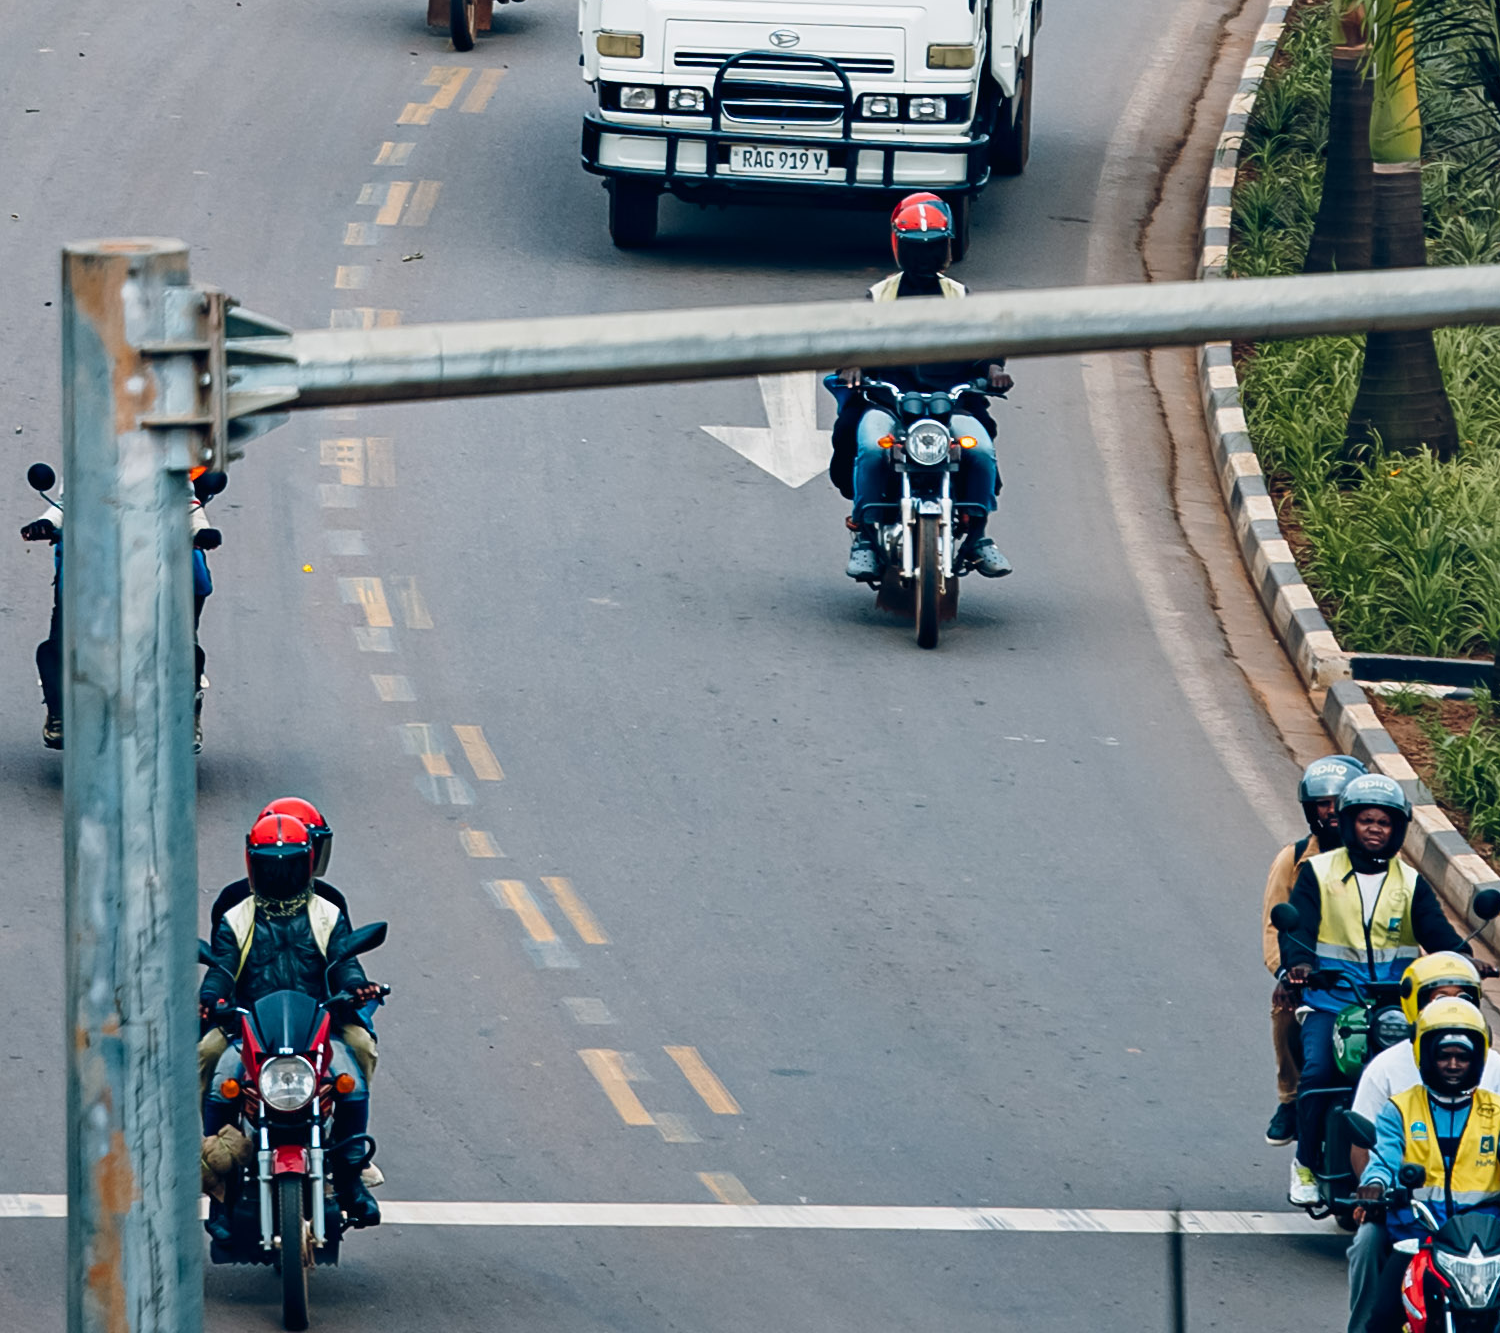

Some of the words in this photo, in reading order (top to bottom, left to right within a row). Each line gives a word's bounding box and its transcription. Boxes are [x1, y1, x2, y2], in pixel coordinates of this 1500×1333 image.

[743, 150, 774, 169] RAG
[779, 151, 809, 170] 919
[813, 152, 824, 171] Y
[1310, 762, 1347, 776] spiro
[1356, 778, 1395, 792] spiro
